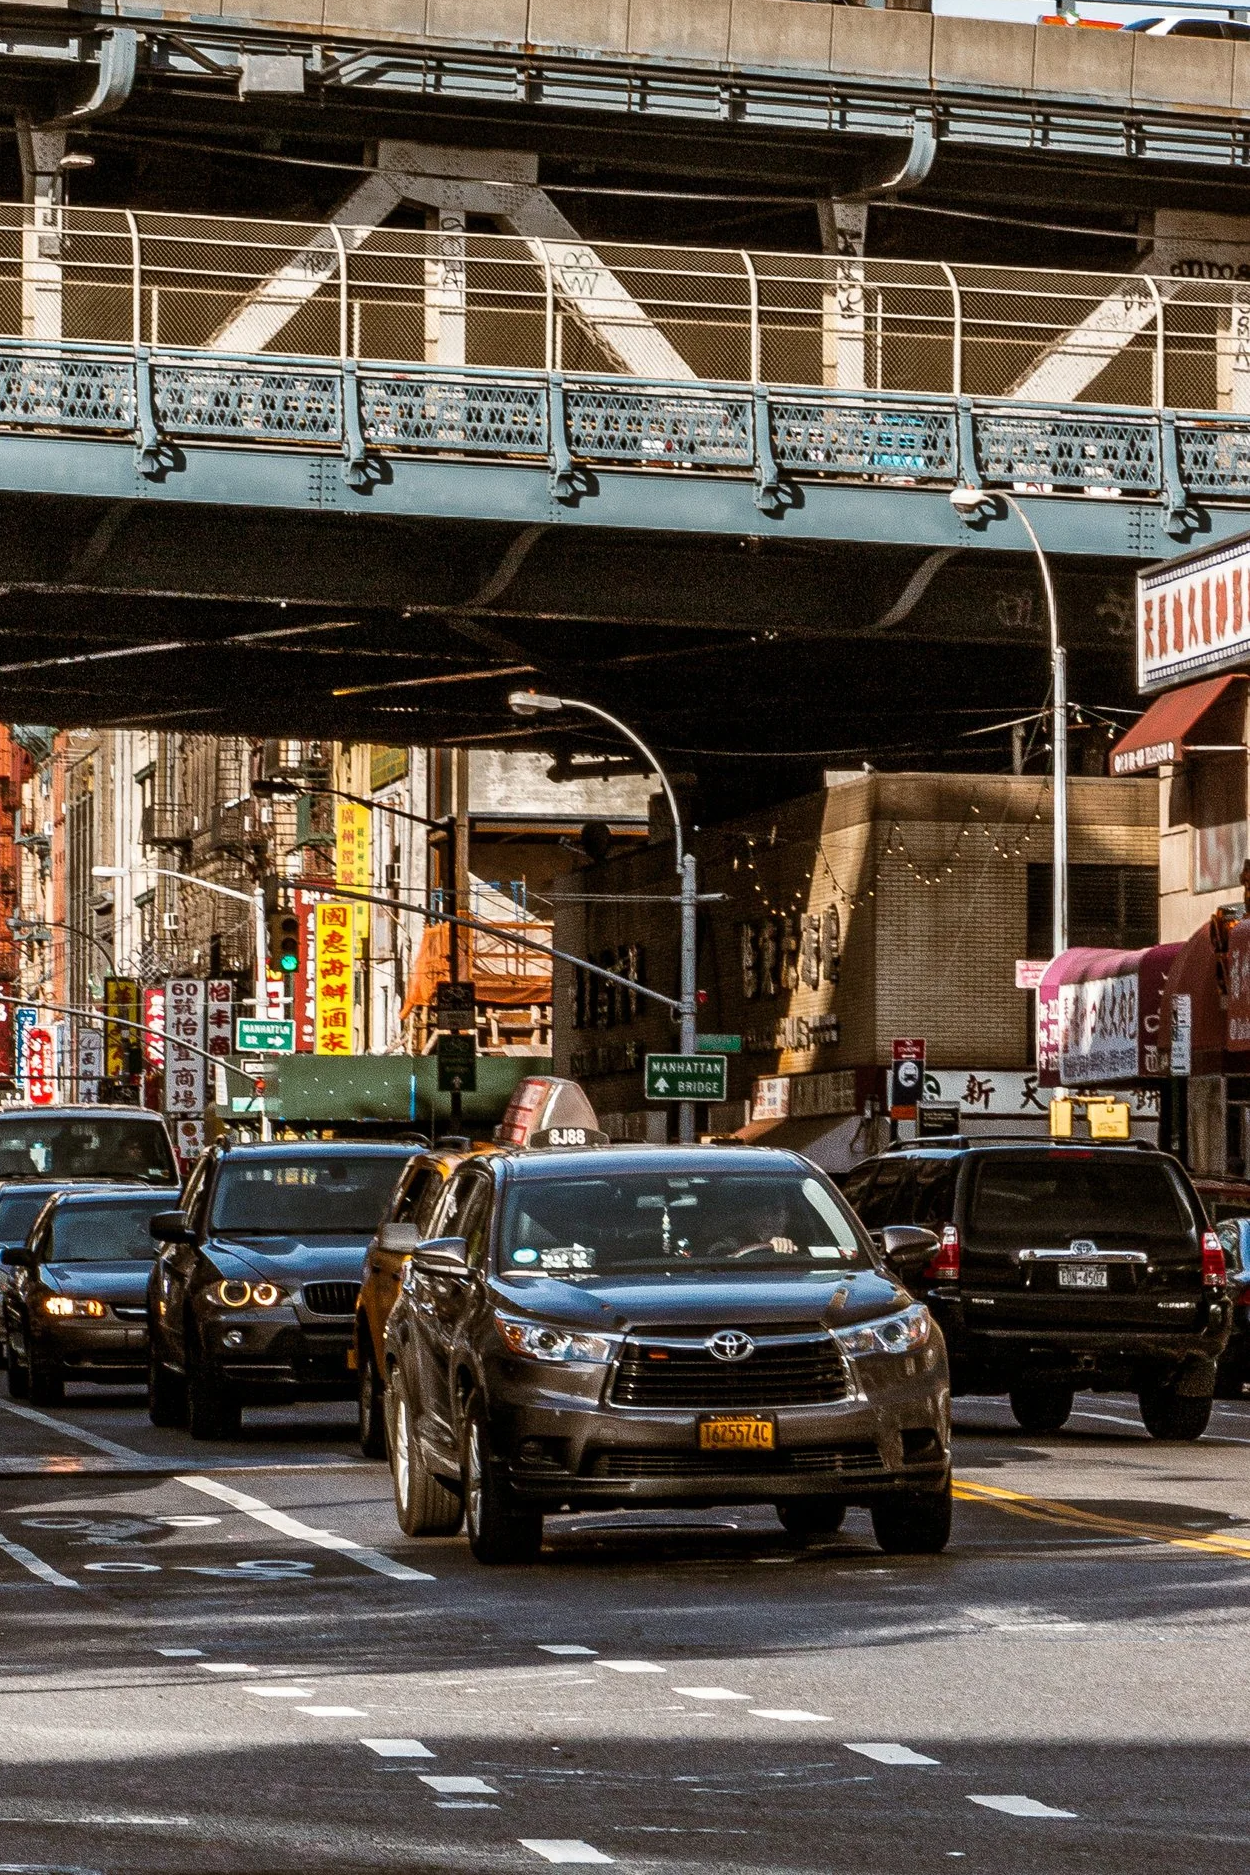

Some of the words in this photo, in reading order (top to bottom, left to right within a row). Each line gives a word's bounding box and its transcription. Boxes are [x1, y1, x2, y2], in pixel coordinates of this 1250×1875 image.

[651, 1061, 721, 1074] MANHATTAN
[678, 1081, 719, 1094] BRIDGE
[549, 1129, 586, 1145] 8J88
[703, 1424, 769, 1443] T625574C
